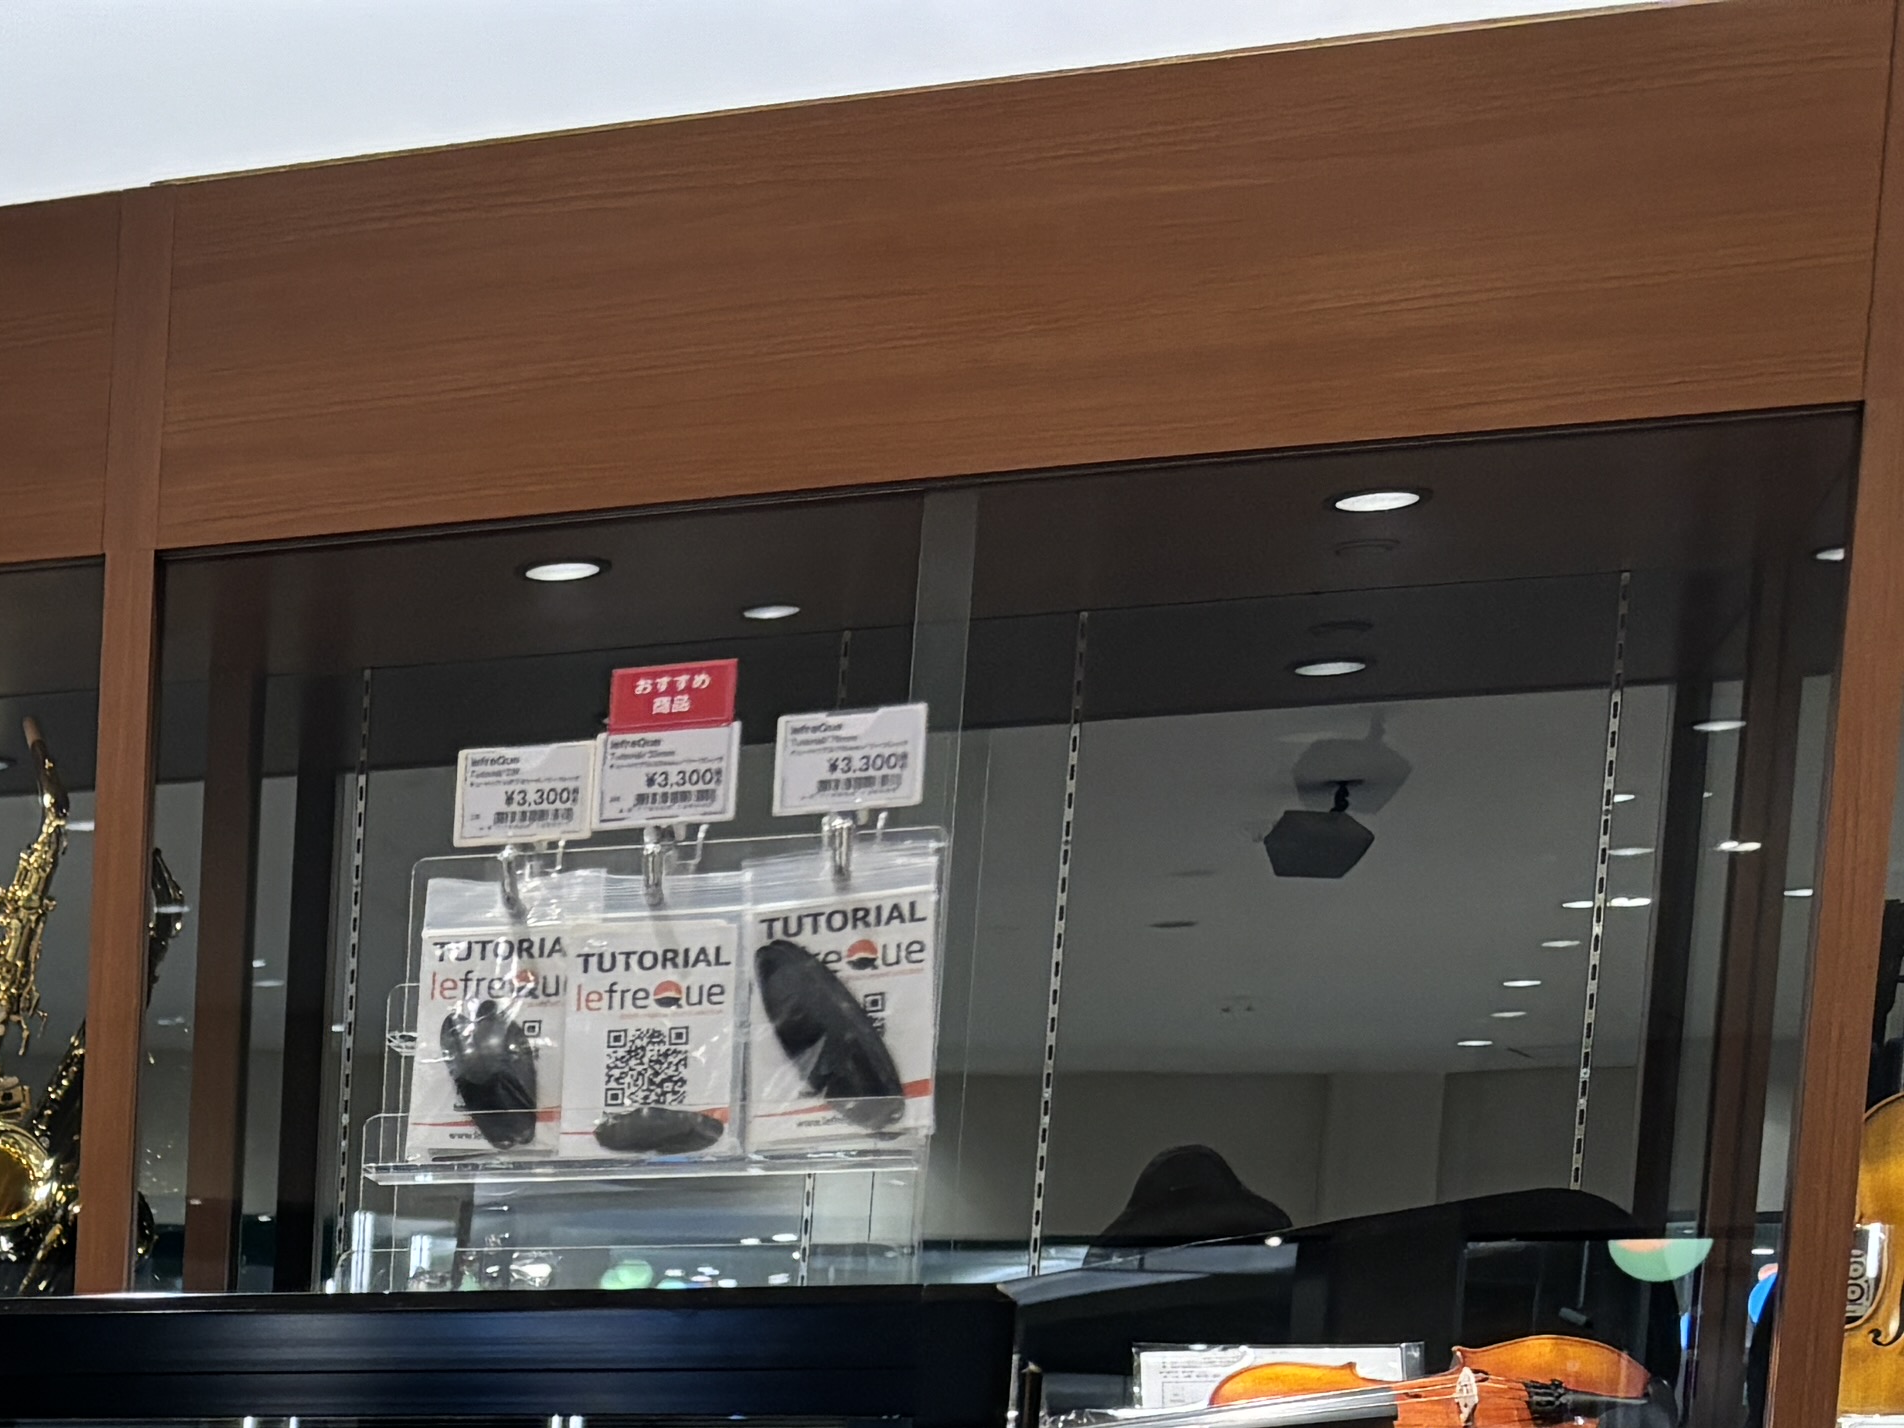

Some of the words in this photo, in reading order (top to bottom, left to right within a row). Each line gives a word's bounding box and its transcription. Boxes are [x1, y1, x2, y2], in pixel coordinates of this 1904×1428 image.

[635, 673, 712, 695] おすすめ
[651, 695, 690, 715] 商品
[828, 754, 900, 774] ¥3,300
[646, 768, 713, 787] ¥3,300
[504, 788, 571, 806] ¥3,300
[759, 899, 927, 941] TUTORIAL
[432, 935, 567, 963] TUTORIA
[576, 945, 731, 975] TUTORIAL
[429, 970, 567, 1003] lefreQu
[575, 981, 726, 1014] lefreQue
